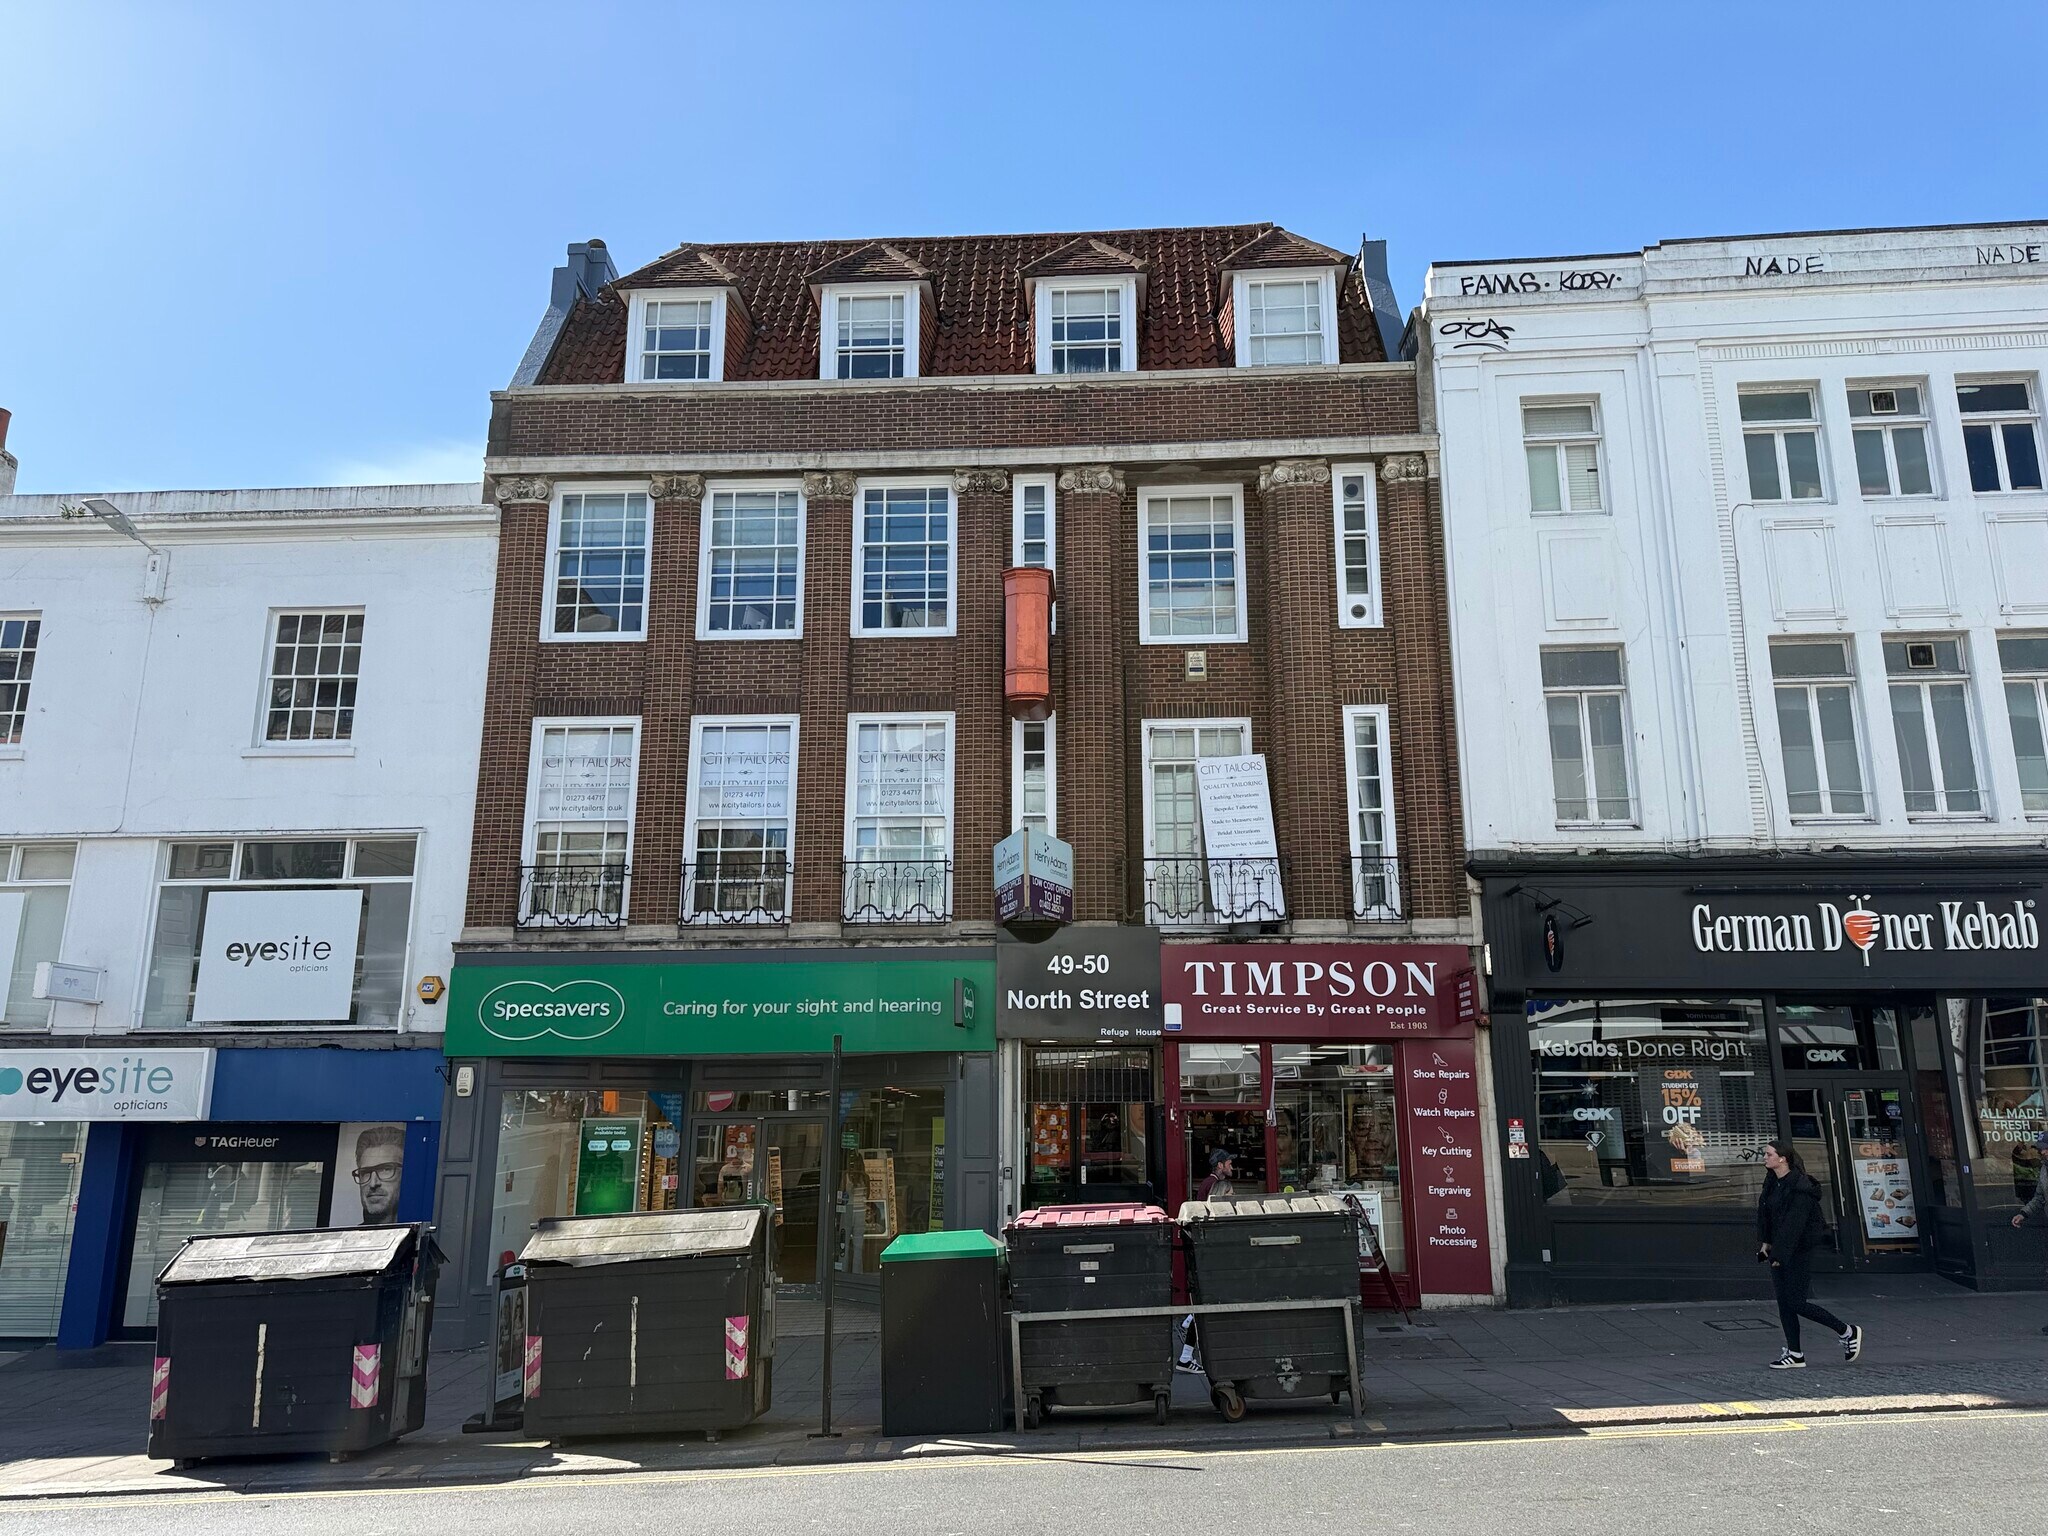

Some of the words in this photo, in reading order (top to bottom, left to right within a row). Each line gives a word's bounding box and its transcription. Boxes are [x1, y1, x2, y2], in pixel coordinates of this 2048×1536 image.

[1976, 245, 2042, 264] NADE
[1745, 256, 1824, 276] NADE
[1200, 764, 1222, 775] CITY
[1224, 761, 1262, 773] TAILORS
[1231, 780, 1263, 788] TAILORING
[549, 804, 623, 813] www.citytailors.o.uk
[708, 801, 781, 809] www.citytailors.o.uk
[866, 799, 938, 807] www.citytailors.o.uk
[1032, 876, 1042, 887] LOW
[1043, 880, 1055, 891] COST
[1055, 885, 1071, 897] OFFICES
[1001, 893, 1008, 904] TO
[1043, 890, 1052, 901] TO
[1053, 894, 1061, 905] LET
[1692, 902, 1816, 952] German
[1938, 900, 2039, 951] Kebab
[225, 935, 332, 968] eyesite
[289, 964, 329, 973] opticians
[1047, 954, 1110, 975] 49-50
[1183, 961, 1438, 997] TIMPSON
[1007, 990, 1072, 1010] North
[1079, 989, 1150, 1009] Street
[493, 1000, 611, 1021] Specsavers
[663, 1000, 717, 1018] Caring
[722, 1000, 748, 1015] for
[752, 1002, 792, 1018] your
[796, 998, 838, 1017] sight
[842, 999, 874, 1013] and
[879, 998, 942, 1016] hearing
[1201, 1003, 1242, 1014] Great
[1246, 1003, 1301, 1014] Service
[1307, 1003, 1325, 1017] By
[1330, 1003, 1371, 1015] Great
[1376, 1004, 1427, 1016] People
[1389, 1021, 1405, 1030] Est
[1407, 1021, 1428, 1030] 1903
[1100, 1028, 1130, 1038] Refuge
[1135, 1028, 1162, 1036] House
[1538, 1040, 1623, 1057] Kebabs.
[1627, 1039, 1686, 1057] Done
[1692, 1039, 1752, 1061] Right.
[1806, 1049, 1847, 1062] GDK
[26, 1057, 174, 1103] eyesite
[1413, 1069, 1436, 1079] Shoe
[1438, 1069, 1470, 1081] Repairs
[1664, 1069, 1694, 1080] GDK
[1661, 1088, 1702, 1107] 15%
[113, 1099, 168, 1112] opticians
[1413, 1108, 1441, 1117] Watch
[1444, 1108, 1476, 1118] Repairs
[1573, 1107, 1615, 1121] GDK
[1662, 1106, 1701, 1125] OFF
[1980, 1108, 2004, 1119] ALL
[2006, 1108, 2044, 1119] MADE
[1993, 1120, 2031, 1130] FRESH
[656, 1130, 675, 1144] Big
[1983, 1130, 2001, 1142] TO
[2004, 1130, 2038, 1142] ORDE
[1422, 1146, 1437, 1157] Key
[1439, 1146, 1472, 1158] Cutting
[1859, 1142, 1899, 1157] GDK
[1867, 1163, 1899, 1174] FIVER
[1428, 1186, 1471, 1197] Engraving
[1439, 1225, 1466, 1235] Photo
[1429, 1237, 1478, 1248] Processing
